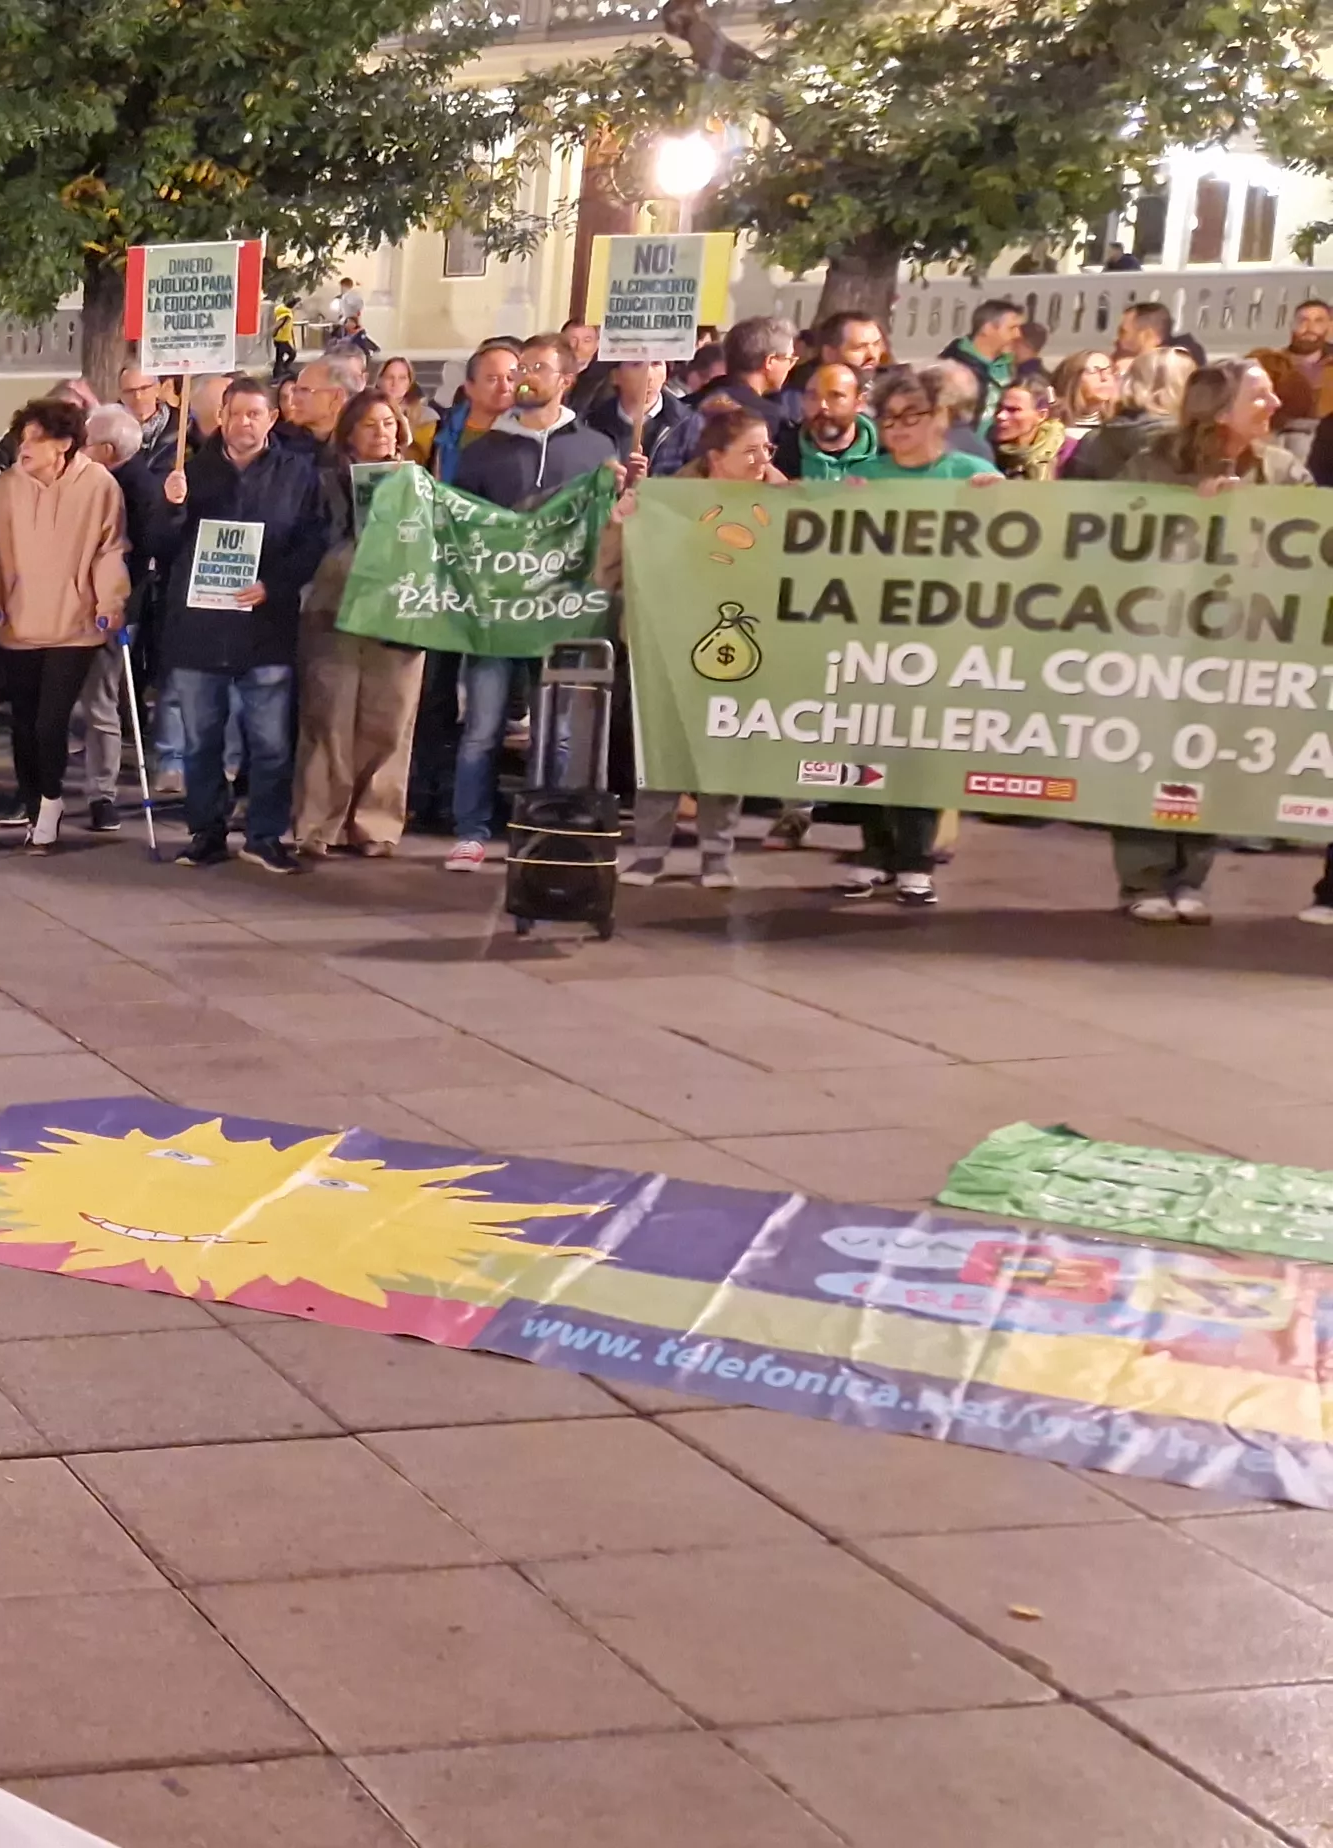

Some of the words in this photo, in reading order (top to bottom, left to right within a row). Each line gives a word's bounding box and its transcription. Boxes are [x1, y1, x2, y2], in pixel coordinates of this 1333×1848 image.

[169, 257, 213, 275] DINERO
[633, 243, 676, 275] NO!
[201, 275, 232, 292] PARA
[148, 297, 162, 313] LA
[216, 528, 245, 550] NO!
[783, 508, 1042, 560] DINERO
[398, 585, 478, 617] PARA
[489, 589, 610, 621] TOD@S
[776, 577, 858, 623] LA
[879, 573, 1301, 649] EDUCACIÓN
[825, 640, 938, 695] ¡NO
[947, 645, 1026, 691] AL
[706, 695, 1154, 774] BACHILLERATO,
[1172, 723, 1277, 773] 0-3
[804, 761, 835, 772] CGT
